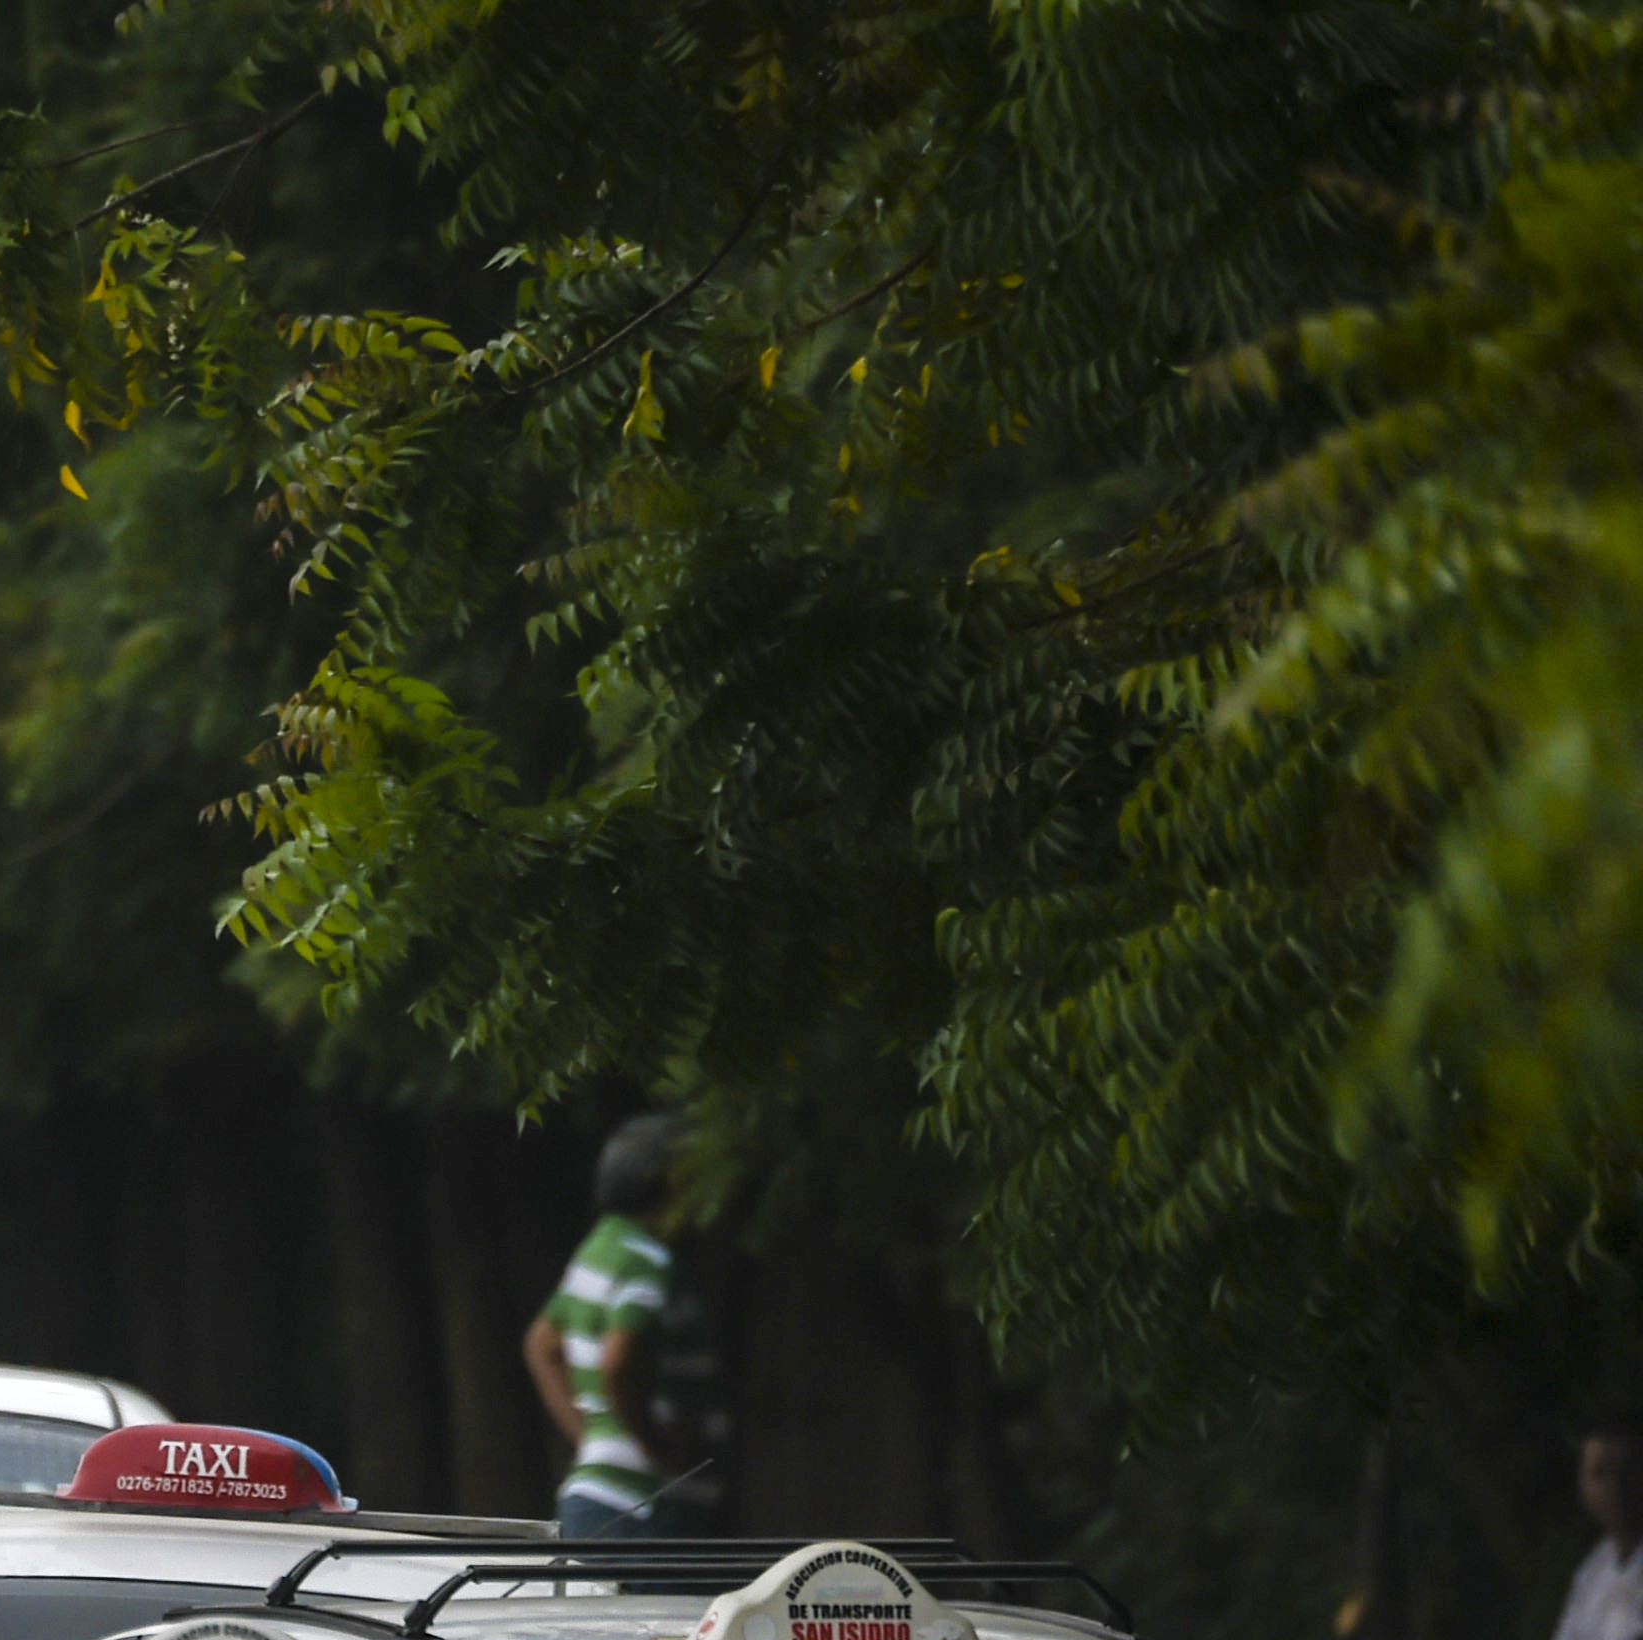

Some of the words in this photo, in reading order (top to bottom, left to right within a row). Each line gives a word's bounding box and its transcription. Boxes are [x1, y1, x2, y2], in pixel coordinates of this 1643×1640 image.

[159, 1440, 250, 1479] TAXI
[116, 1476, 214, 1495] 0276-7871825
[785, 1551, 843, 1601] ASOCIACION
[844, 1550, 914, 1599] COOPERATIVA
[788, 1604, 809, 1620] DE
[812, 1604, 913, 1620] TRANSPORTE
